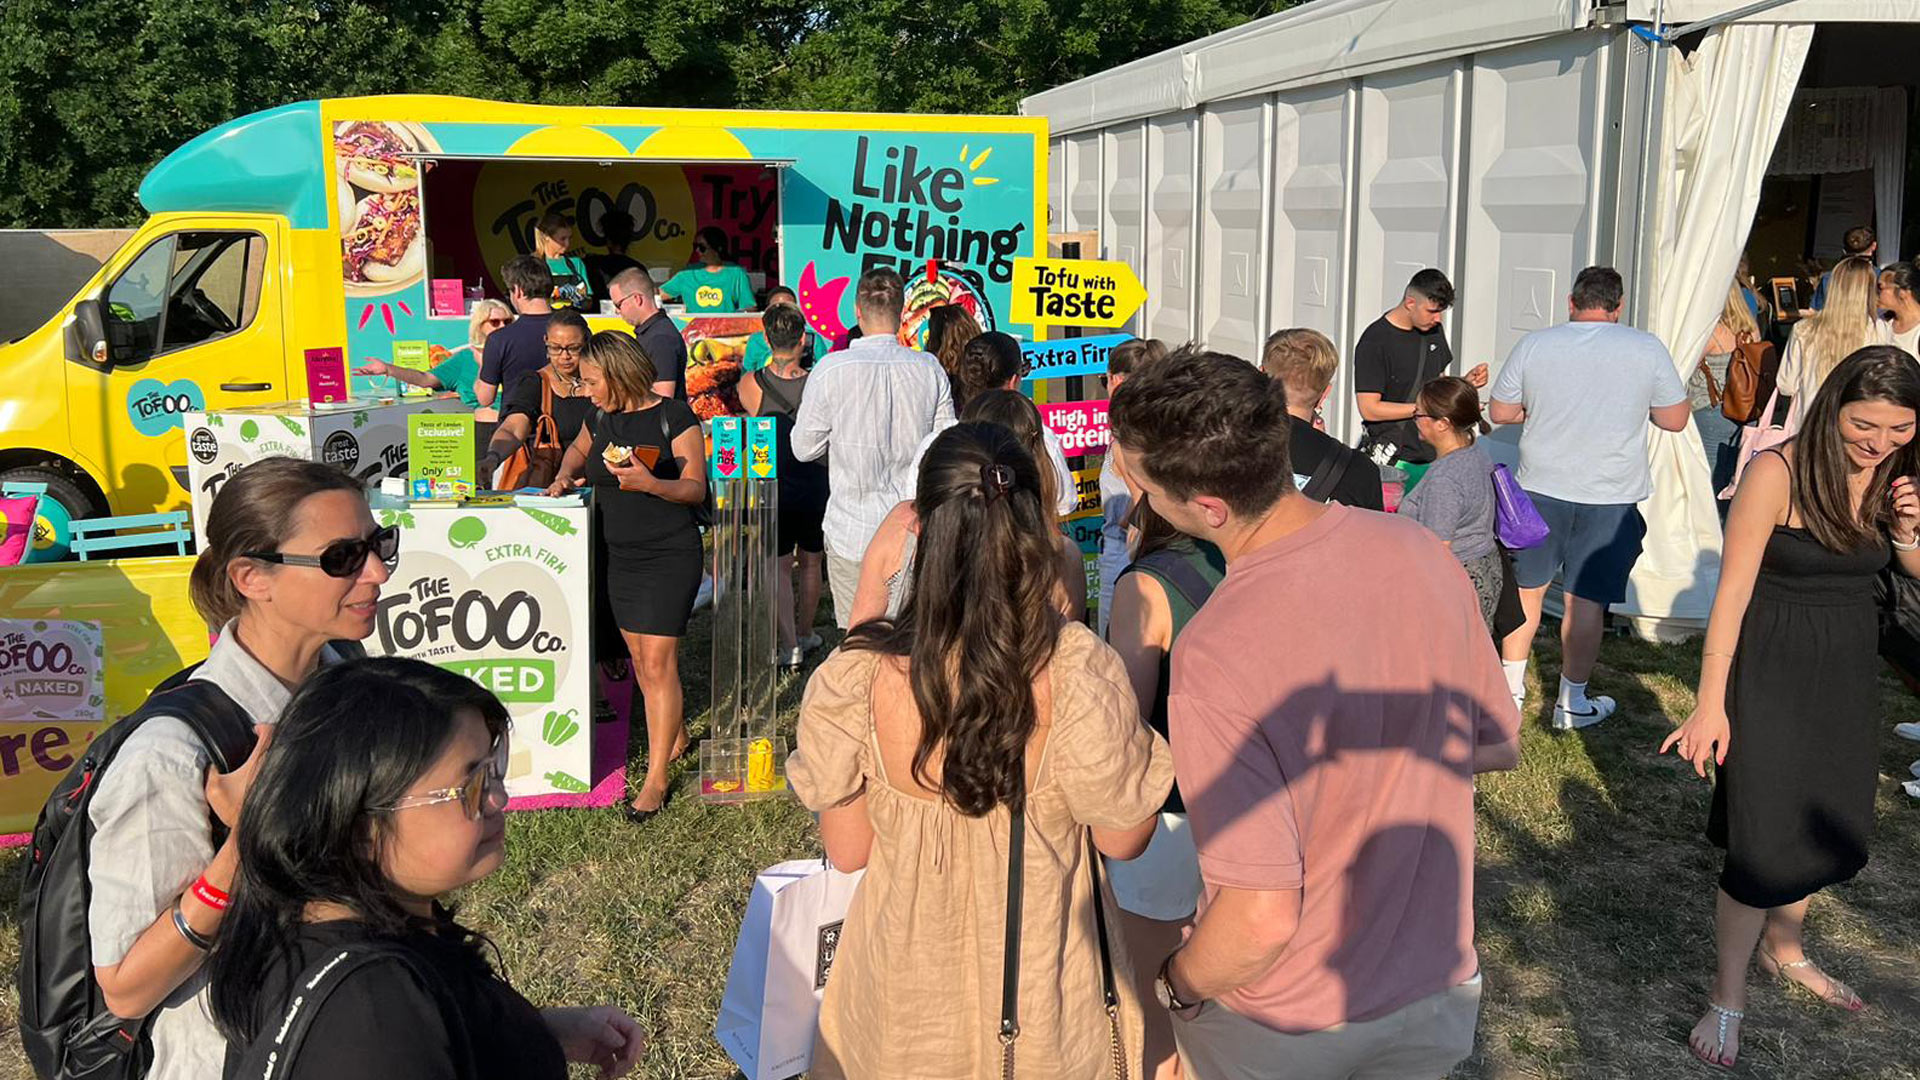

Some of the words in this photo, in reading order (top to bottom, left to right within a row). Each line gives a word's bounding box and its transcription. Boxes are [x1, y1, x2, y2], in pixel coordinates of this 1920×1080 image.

[853, 136, 964, 213] Like
[532, 179, 570, 206] THE
[822, 198, 1025, 284] Nothing
[1034, 266, 1078, 287] Tofu
[1083, 275, 1116, 291] with
[1029, 286, 1116, 319] Taste
[1022, 348, 1076, 371] Extra
[1081, 343, 1113, 365] Fir
[1048, 409, 1088, 432] High
[1092, 407, 1109, 425] in
[192, 441, 217, 452] taste
[325, 446, 358, 464] taste
[380, 442, 408, 469] THE
[422, 467, 443, 477] Only
[485, 543, 532, 562] EXTRA
[535, 548, 568, 575] FIRM
[409, 576, 451, 602] THE
[376, 589, 541, 655] TOFOO
[4, 633, 26, 645] THE
[428, 644, 457, 657] TASTE
[19, 681, 80, 695] NAKED
[463, 665, 545, 693] KED
